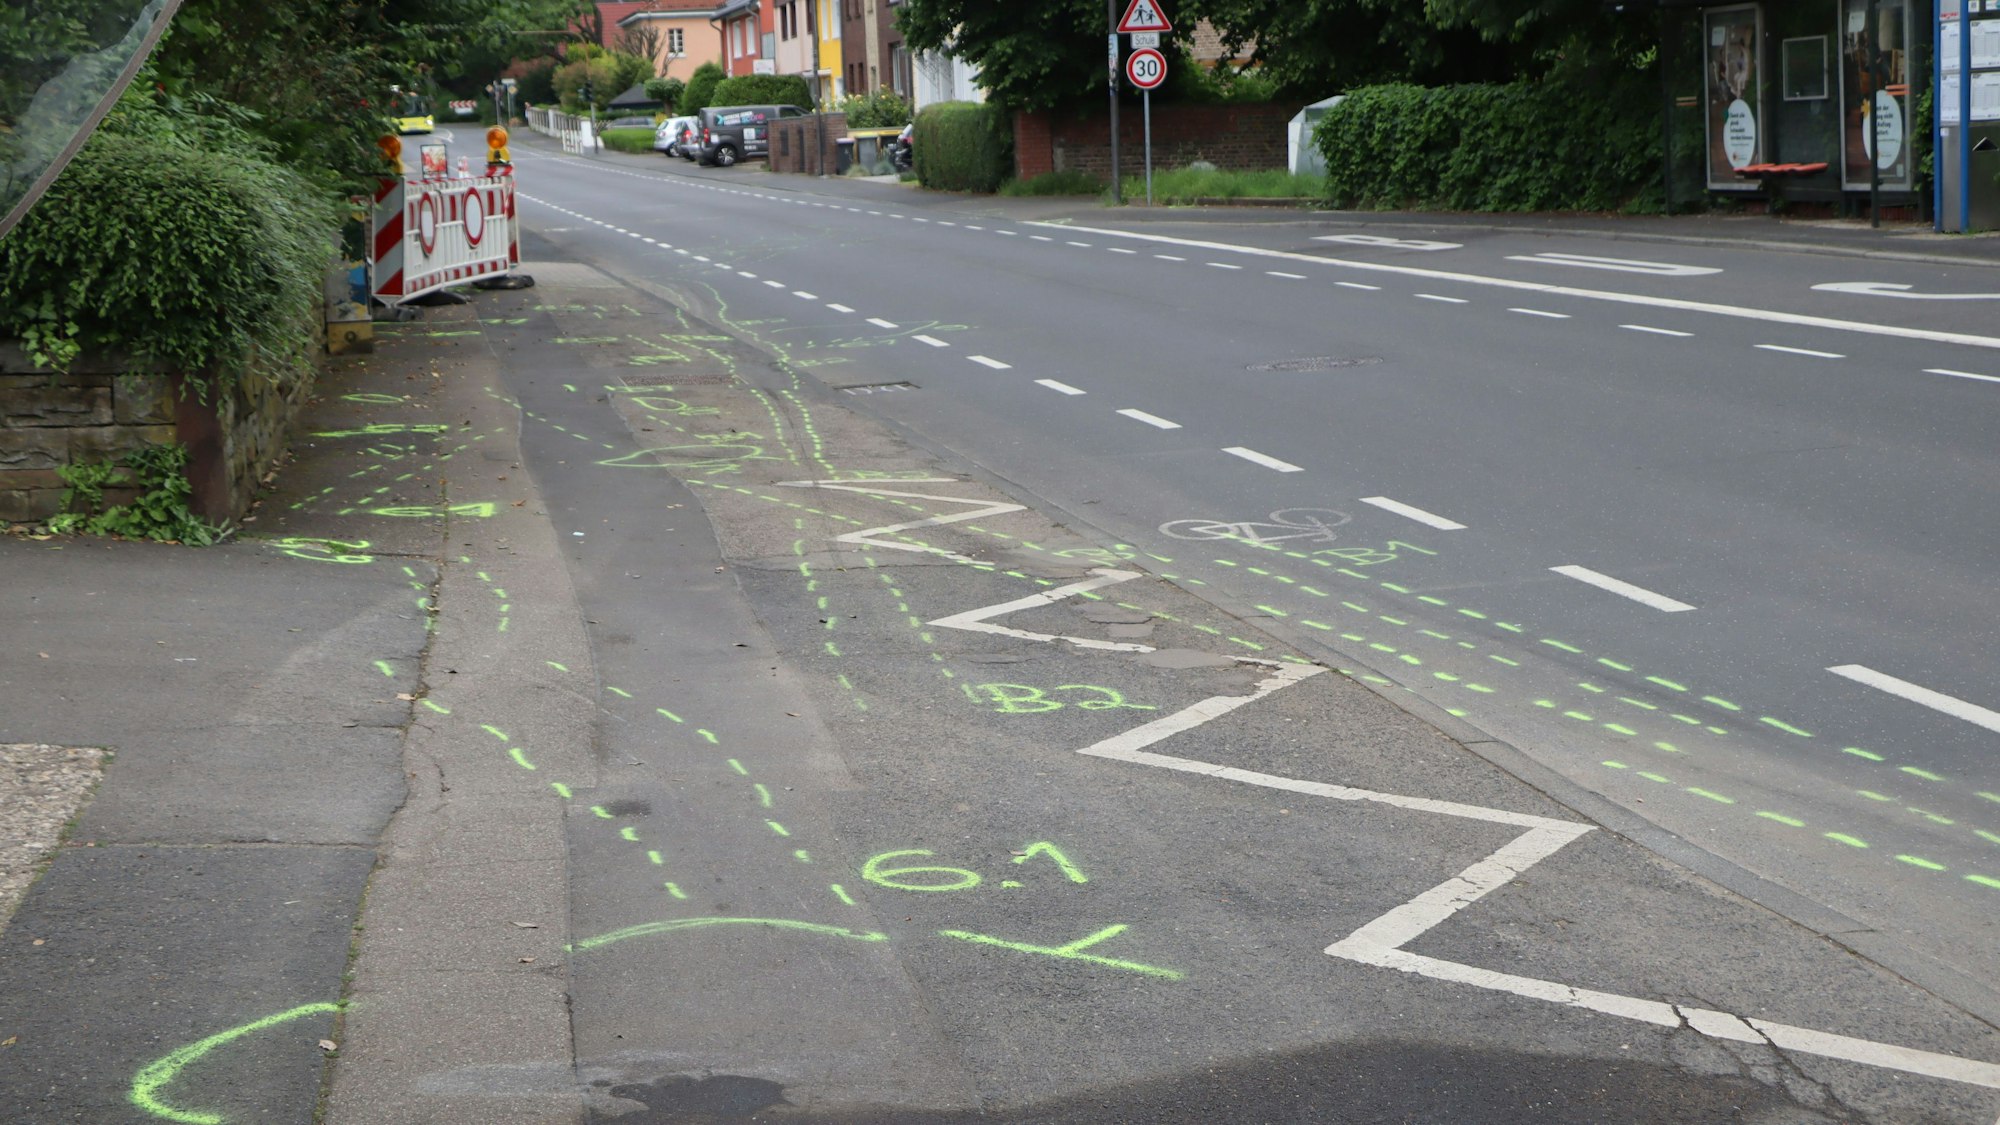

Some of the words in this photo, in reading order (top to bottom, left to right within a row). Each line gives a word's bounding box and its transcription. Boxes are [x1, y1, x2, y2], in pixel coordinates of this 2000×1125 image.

[1134, 34, 1156, 46] Schule
[1136, 59, 1158, 77] 30
[1311, 541, 1438, 566] B1
[977, 683, 1156, 714] B2
[861, 841, 1089, 891] 6.1
